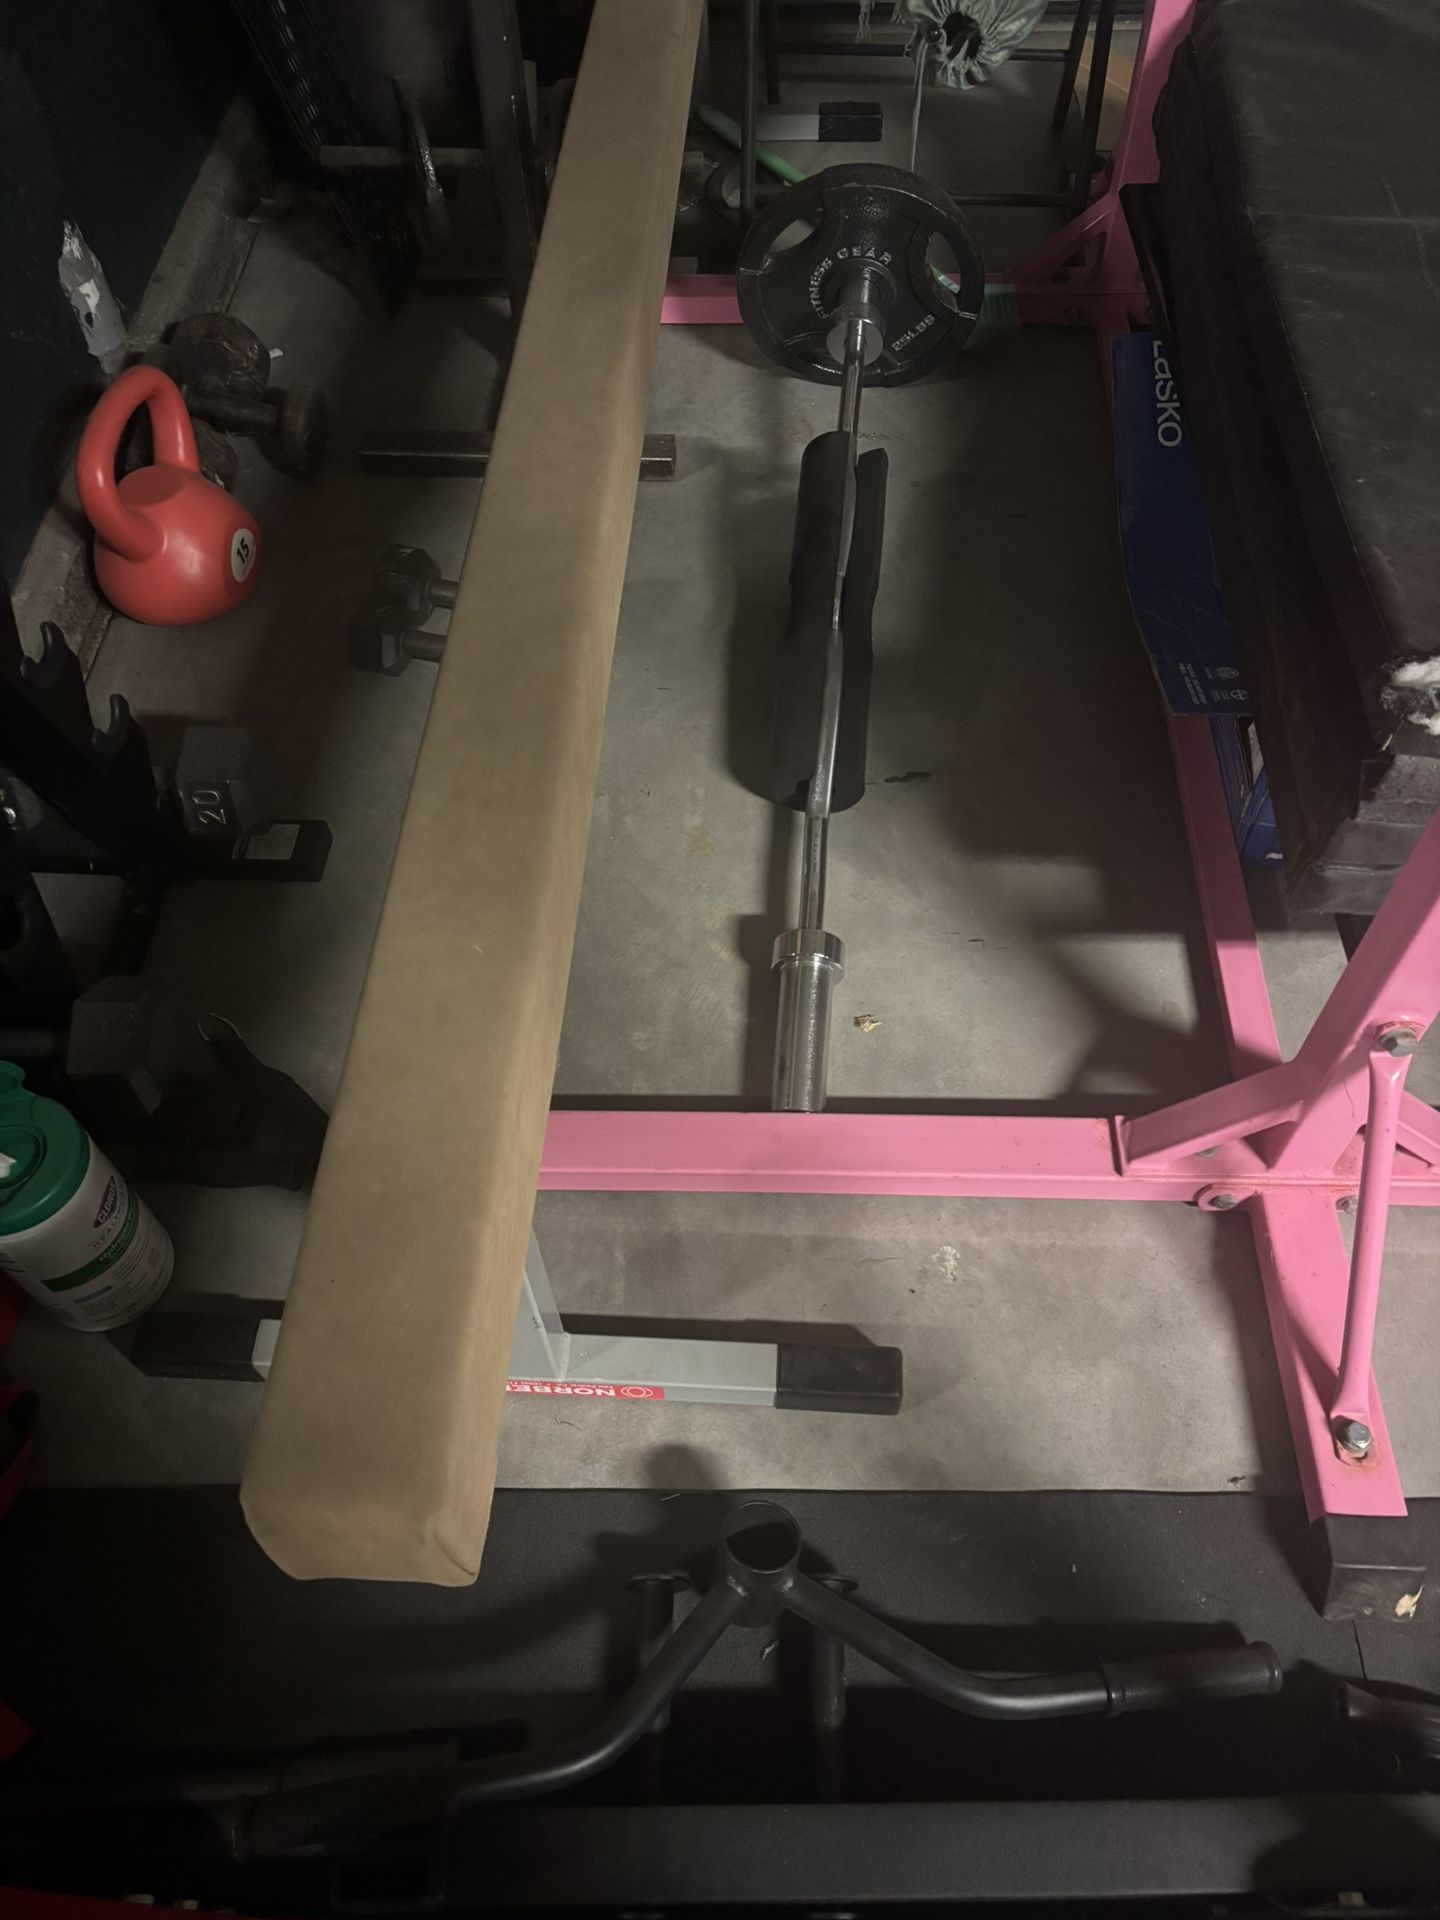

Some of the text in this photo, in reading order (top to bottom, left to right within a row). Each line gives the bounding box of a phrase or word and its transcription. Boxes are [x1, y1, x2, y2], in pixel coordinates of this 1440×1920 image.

[808, 246, 893, 320] FITNESS GEAR
[236, 537, 250, 564] 15
[192, 789, 227, 825] 20
